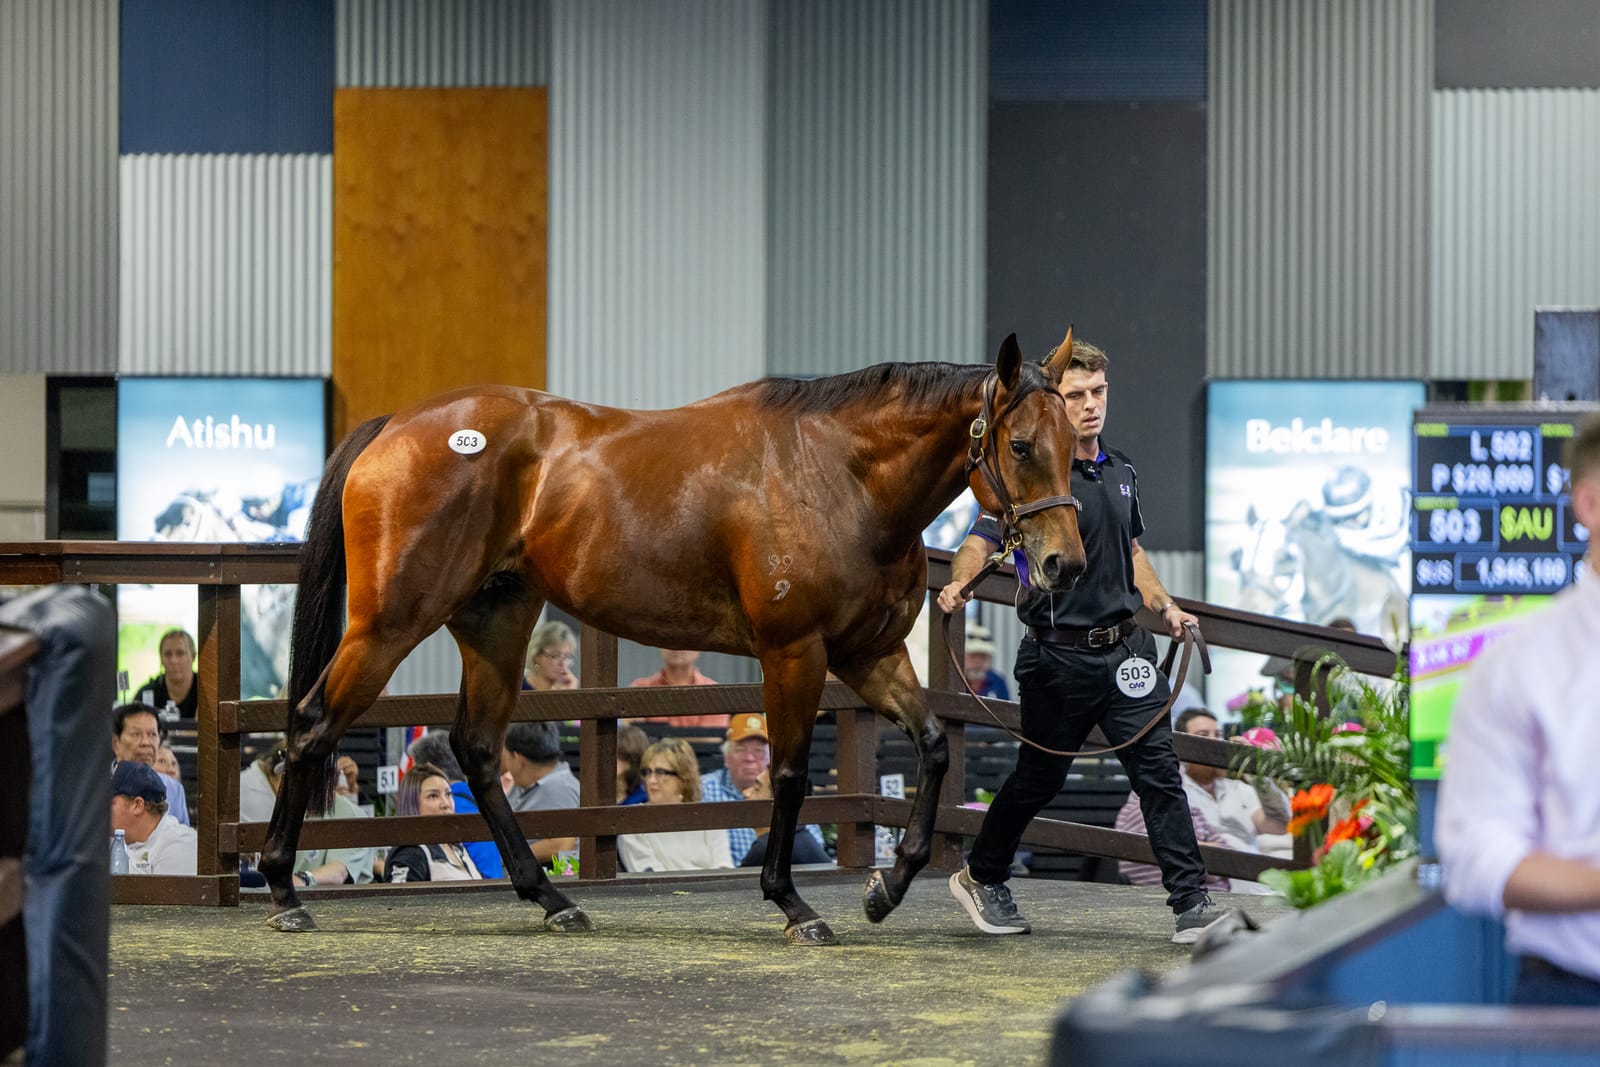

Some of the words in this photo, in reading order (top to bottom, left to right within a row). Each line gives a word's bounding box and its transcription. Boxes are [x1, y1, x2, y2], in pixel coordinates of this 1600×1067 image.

[166, 414, 276, 449] Atishu
[457, 436, 477, 447] 503
[1246, 417, 1389, 454] Belclare
[1490, 430, 1533, 462] 502
[1432, 463, 1451, 494] P
[1429, 508, 1482, 544] 503
[1121, 665, 1151, 682] 503
[381, 770, 395, 788] 51
[885, 778, 900, 796] 52
[971, 889, 984, 912] HOKA
